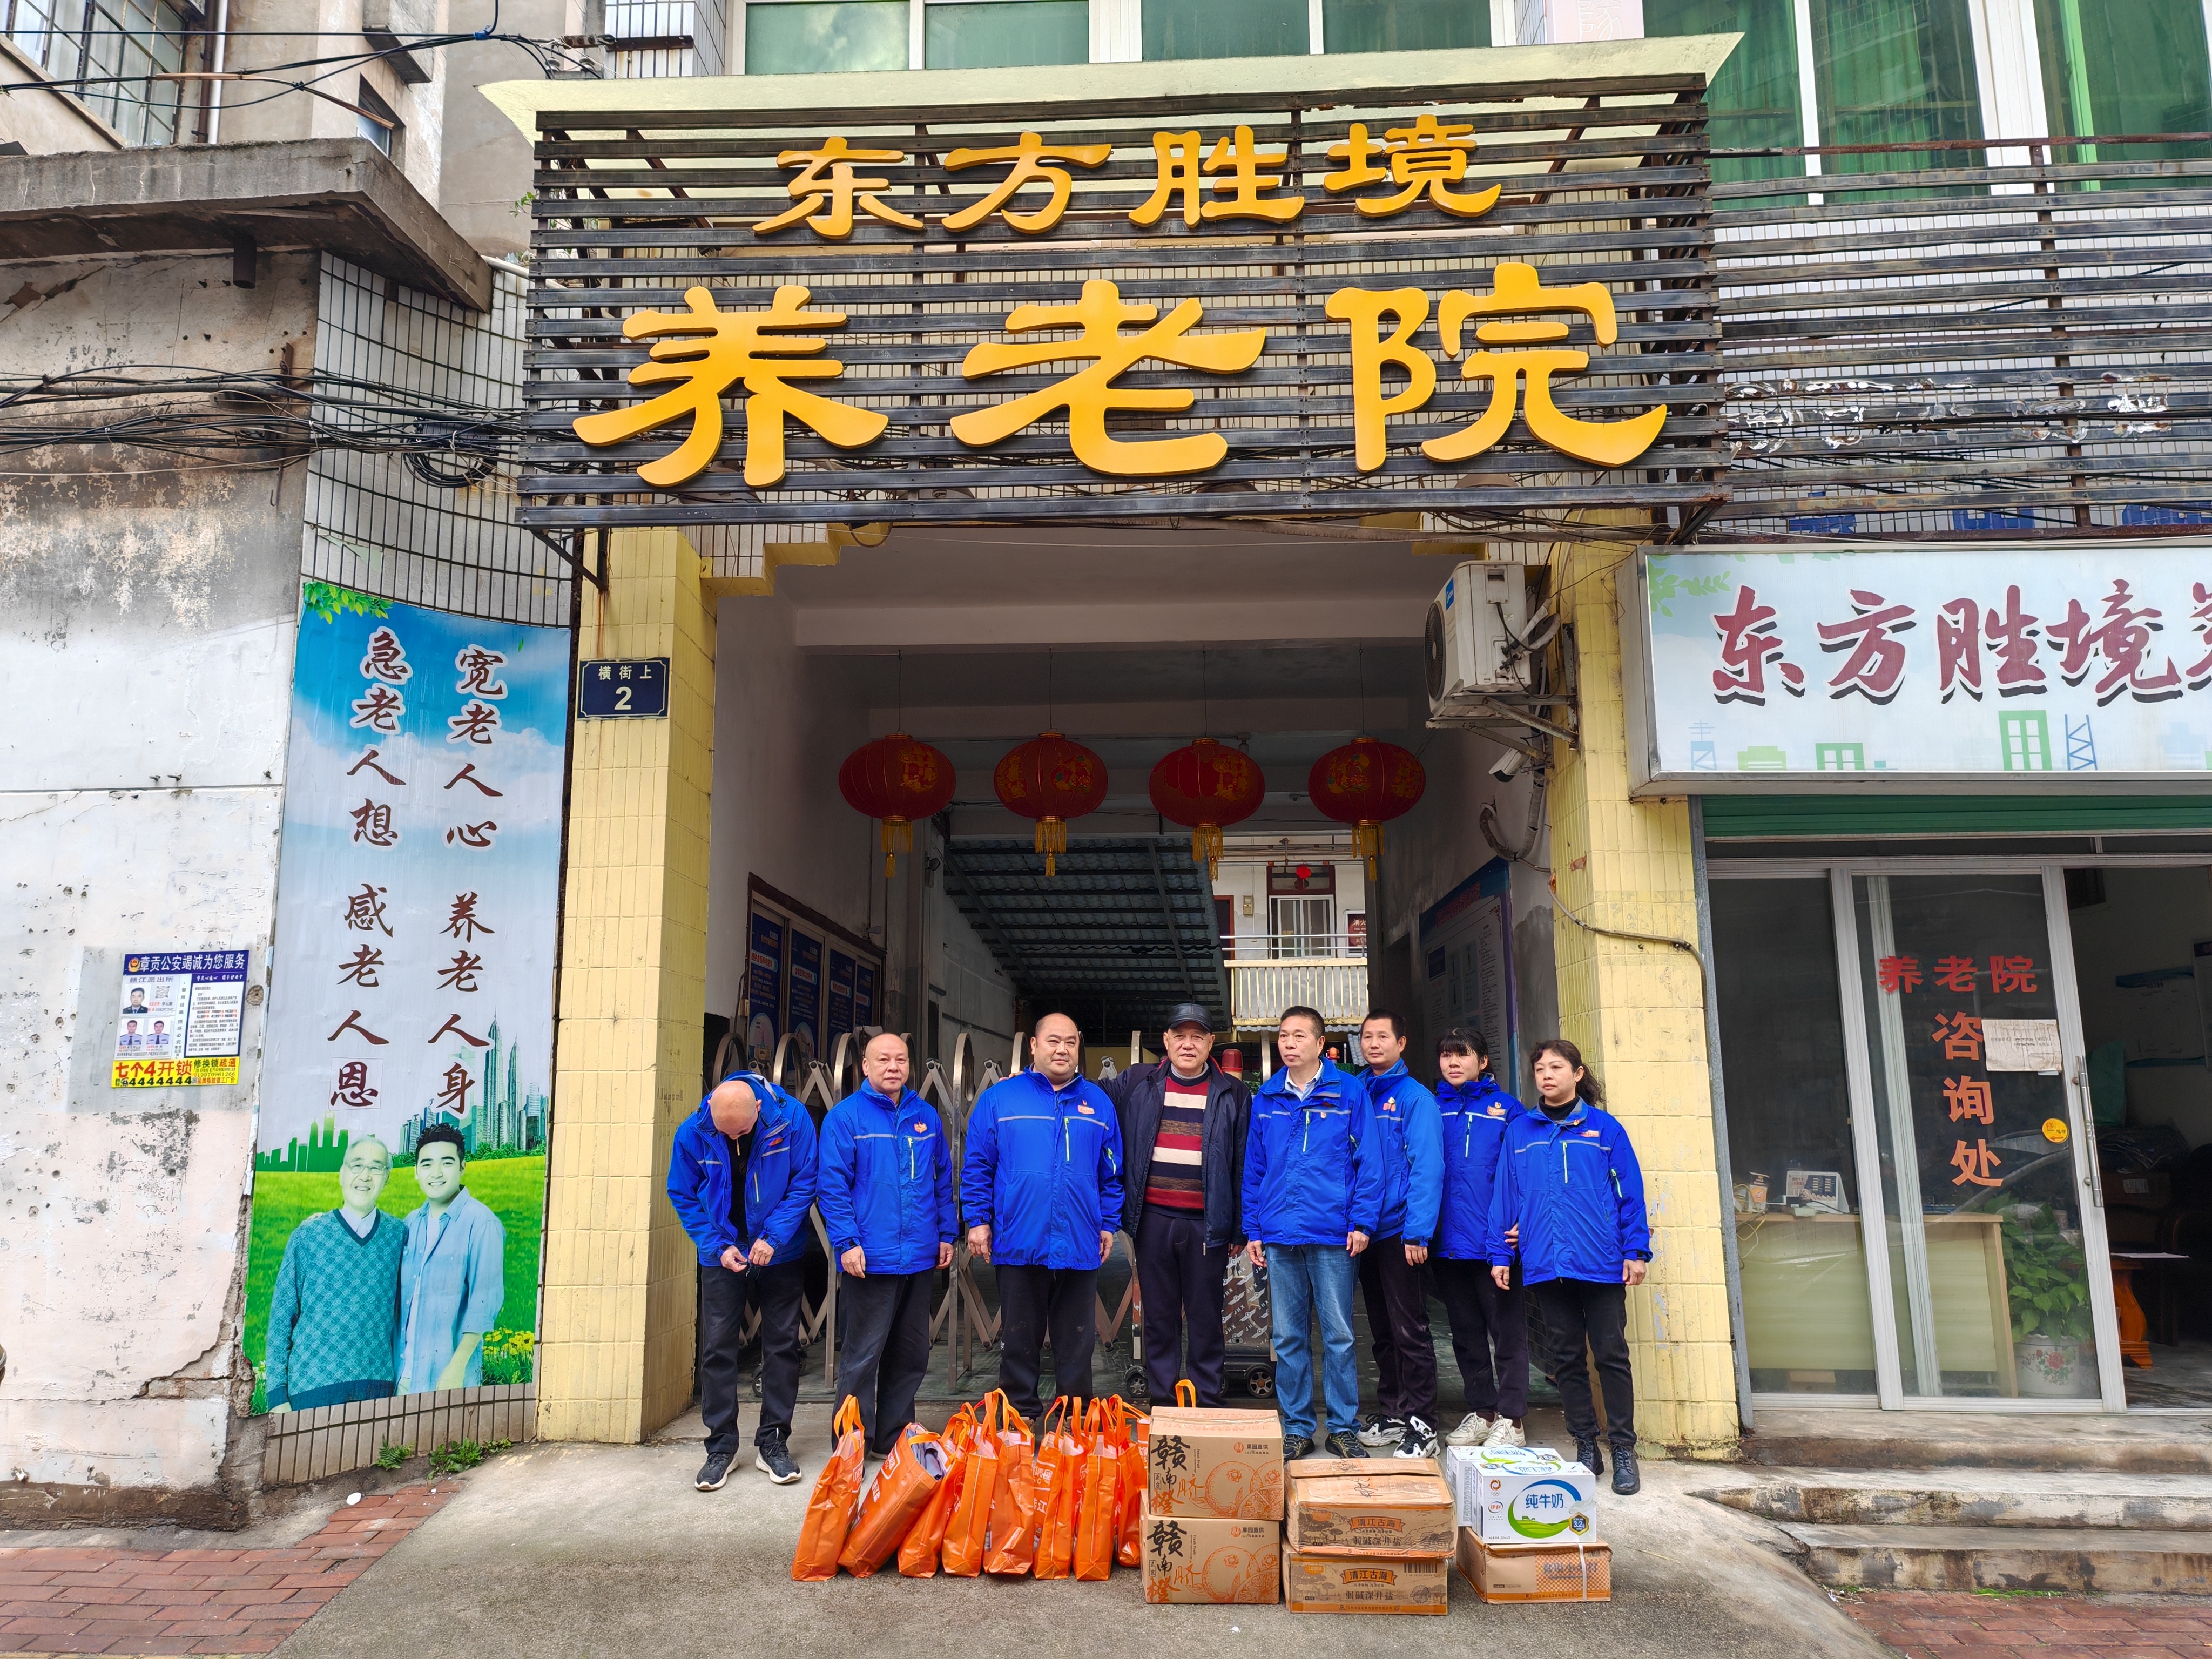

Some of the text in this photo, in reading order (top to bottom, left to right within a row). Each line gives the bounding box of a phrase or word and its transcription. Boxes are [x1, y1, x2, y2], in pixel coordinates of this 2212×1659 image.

[753, 114, 1502, 239] 东方胜境
[573, 262, 1668, 487] 养老院
[1711, 579, 2212, 707] 东方胜境
[598, 665, 652, 680] 横街上
[614, 686, 632, 710] 2
[328, 630, 412, 1108] 急老人想 感老人恩
[428, 649, 505, 1114] 宽老人心 养老人身
[140, 953, 245, 972] 章贡公安竭诚为您服务
[1879, 955, 2038, 994] 养老院
[116, 1060, 192, 1078] 七个4开锁
[194, 1058, 236, 1068] 修换锁疏通
[129, 1076, 192, 1085] 4444444
[1932, 1011, 2002, 1187] 咨询处
[1526, 1493, 1564, 1509] 纯牛奶
[1353, 1535, 1401, 1546] 弱碱深井盐
[1345, 1590, 1394, 1601] 弱碱深井盐
